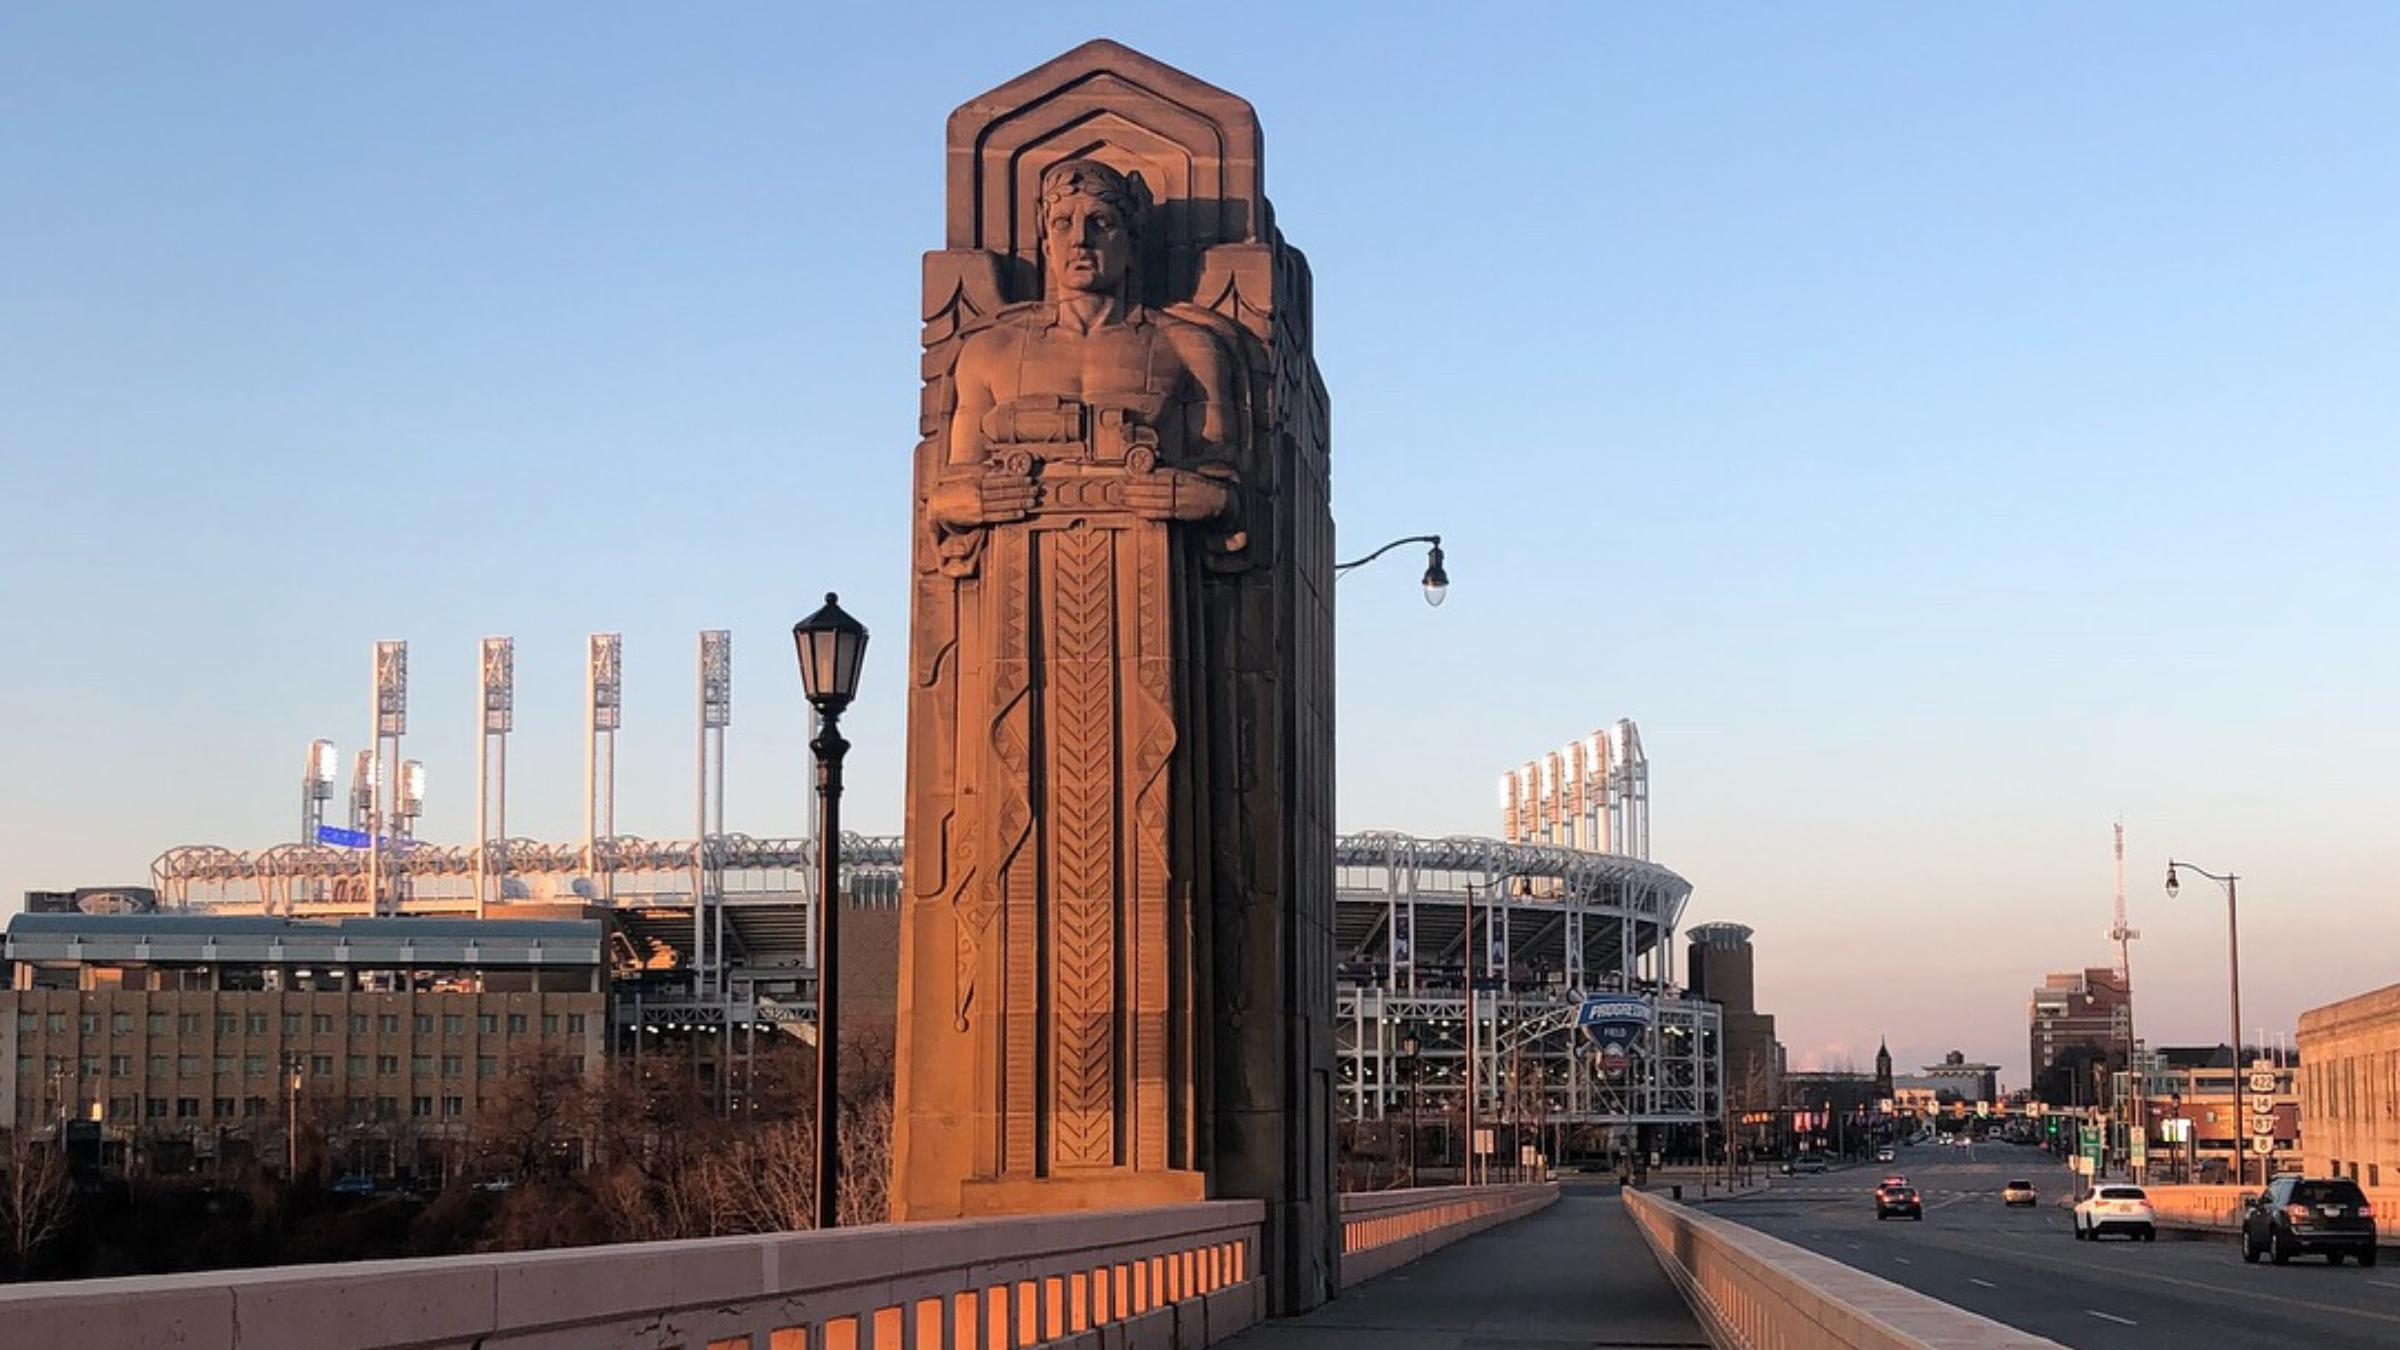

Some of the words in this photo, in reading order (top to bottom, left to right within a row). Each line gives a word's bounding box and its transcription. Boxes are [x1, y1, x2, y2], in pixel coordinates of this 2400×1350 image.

[1604, 1027, 1627, 1038] FIELD
[2252, 1076, 2273, 1089] 422
[2256, 1097, 2269, 1109] 14
[2255, 1118, 2271, 1129] 87
